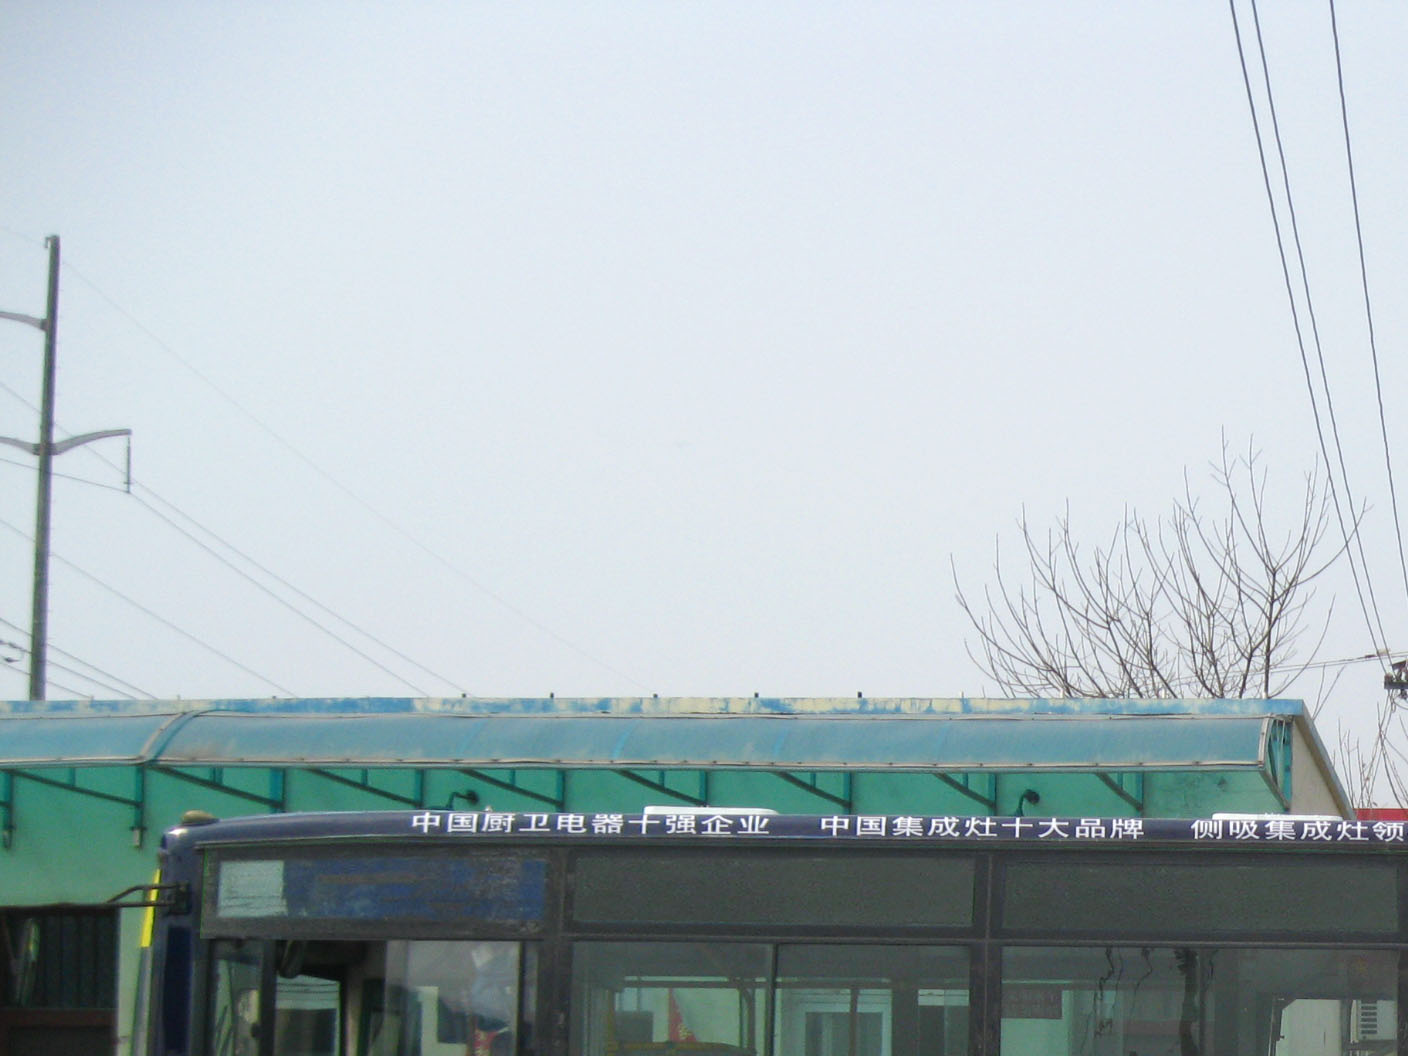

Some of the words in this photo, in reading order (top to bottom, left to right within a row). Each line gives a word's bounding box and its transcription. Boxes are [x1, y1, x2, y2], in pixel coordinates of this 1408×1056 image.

[411, 812, 771, 835] 中国厨卫电器十强企业
[820, 816, 1145, 841] 中国集成灶十大品牌
